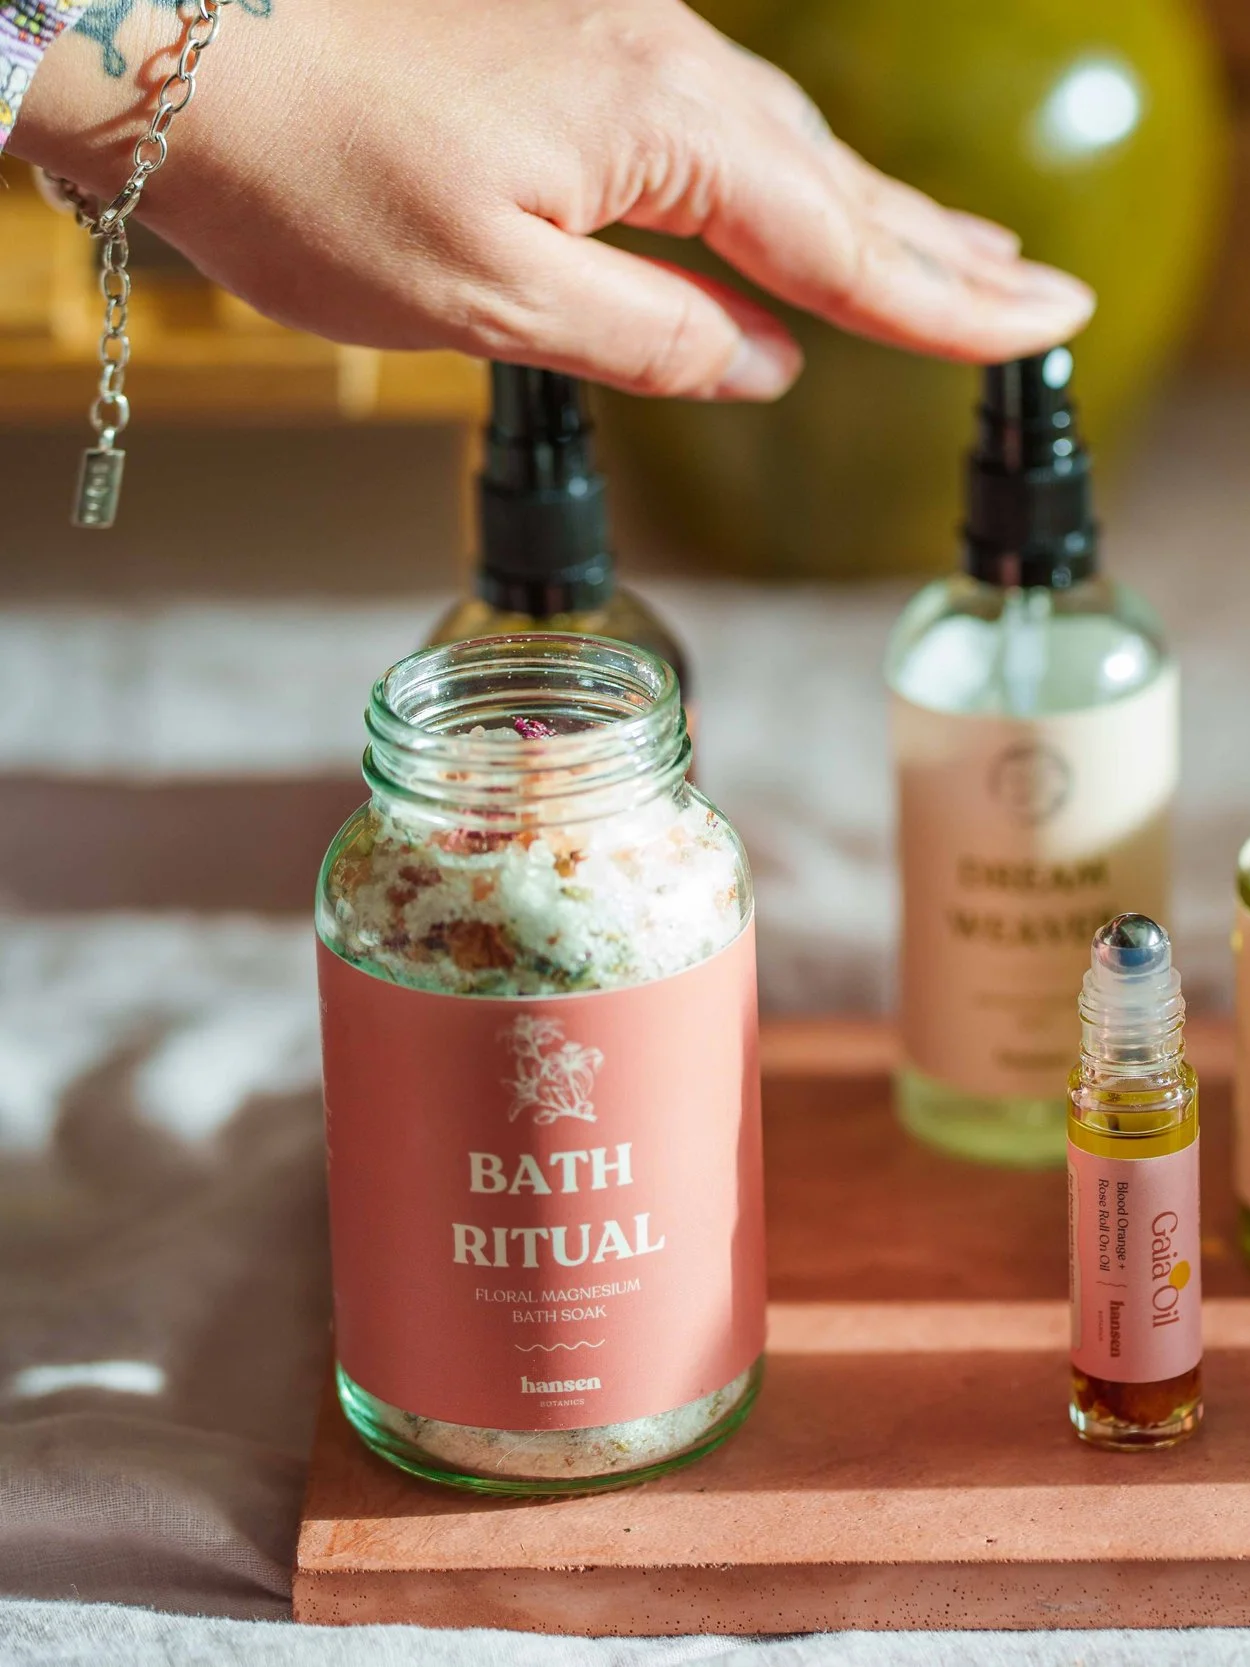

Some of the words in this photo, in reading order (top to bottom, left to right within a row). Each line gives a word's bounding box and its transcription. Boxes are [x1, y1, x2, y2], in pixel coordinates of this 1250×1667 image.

[468, 1142, 634, 1195] BATH
[1098, 1179, 1109, 1207] Rose
[1117, 1182, 1129, 1215] Blood
[1098, 1209, 1110, 1233] Roll
[451, 1212, 665, 1268] RITUAL
[1099, 1234, 1110, 1252] On
[1116, 1216, 1129, 1261] Orange
[1151, 1211, 1179, 1282] Gaia
[1099, 1254, 1110, 1272] Oil
[475, 1287, 538, 1304] FLORAL
[541, 1278, 642, 1304] MAGNESIUM
[512, 1309, 557, 1324] BATH
[561, 1306, 607, 1322] SOAK
[1152, 1284, 1180, 1328] Oil
[1110, 1300, 1124, 1358] hansen
[520, 1376, 602, 1394] hansen
[539, 1398, 585, 1408] BOTANICS
